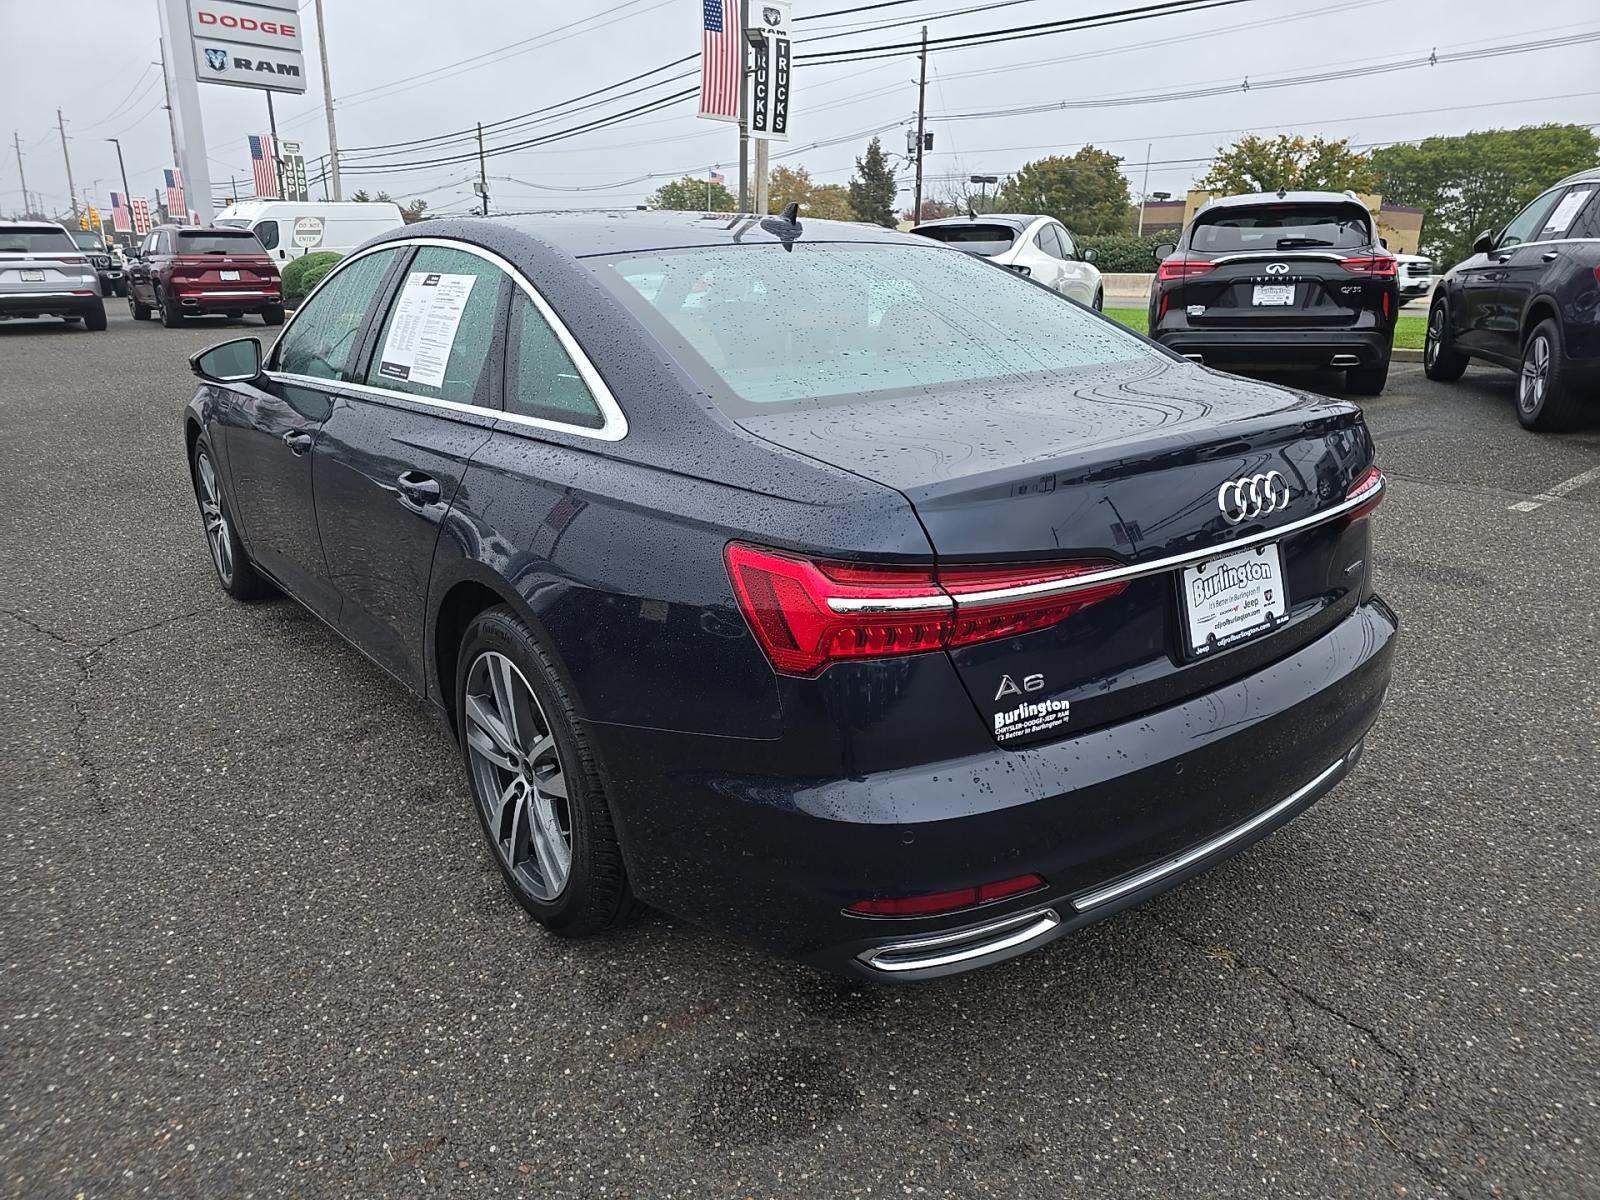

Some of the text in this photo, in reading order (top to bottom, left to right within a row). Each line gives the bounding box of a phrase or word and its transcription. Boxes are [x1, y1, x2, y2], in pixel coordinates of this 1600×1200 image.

[198, 11, 297, 37] DODGE
[233, 57, 300, 77] RAM
[755, 54, 767, 127] RUCKS
[775, 42, 787, 129] TRUCKS
[285, 162, 296, 193] Jeep
[297, 162, 307, 193] Jeep
[1193, 560, 1272, 608] Burlington
[1234, 587, 1256, 602] Burlington
[1243, 598, 1259, 609] Jeep
[1195, 645, 1209, 655] Jeep
[994, 673, 1045, 701] A6
[994, 700, 1070, 729] Burlington
[1005, 729, 1025, 740] Better
[1031, 719, 1063, 732] Burlington
